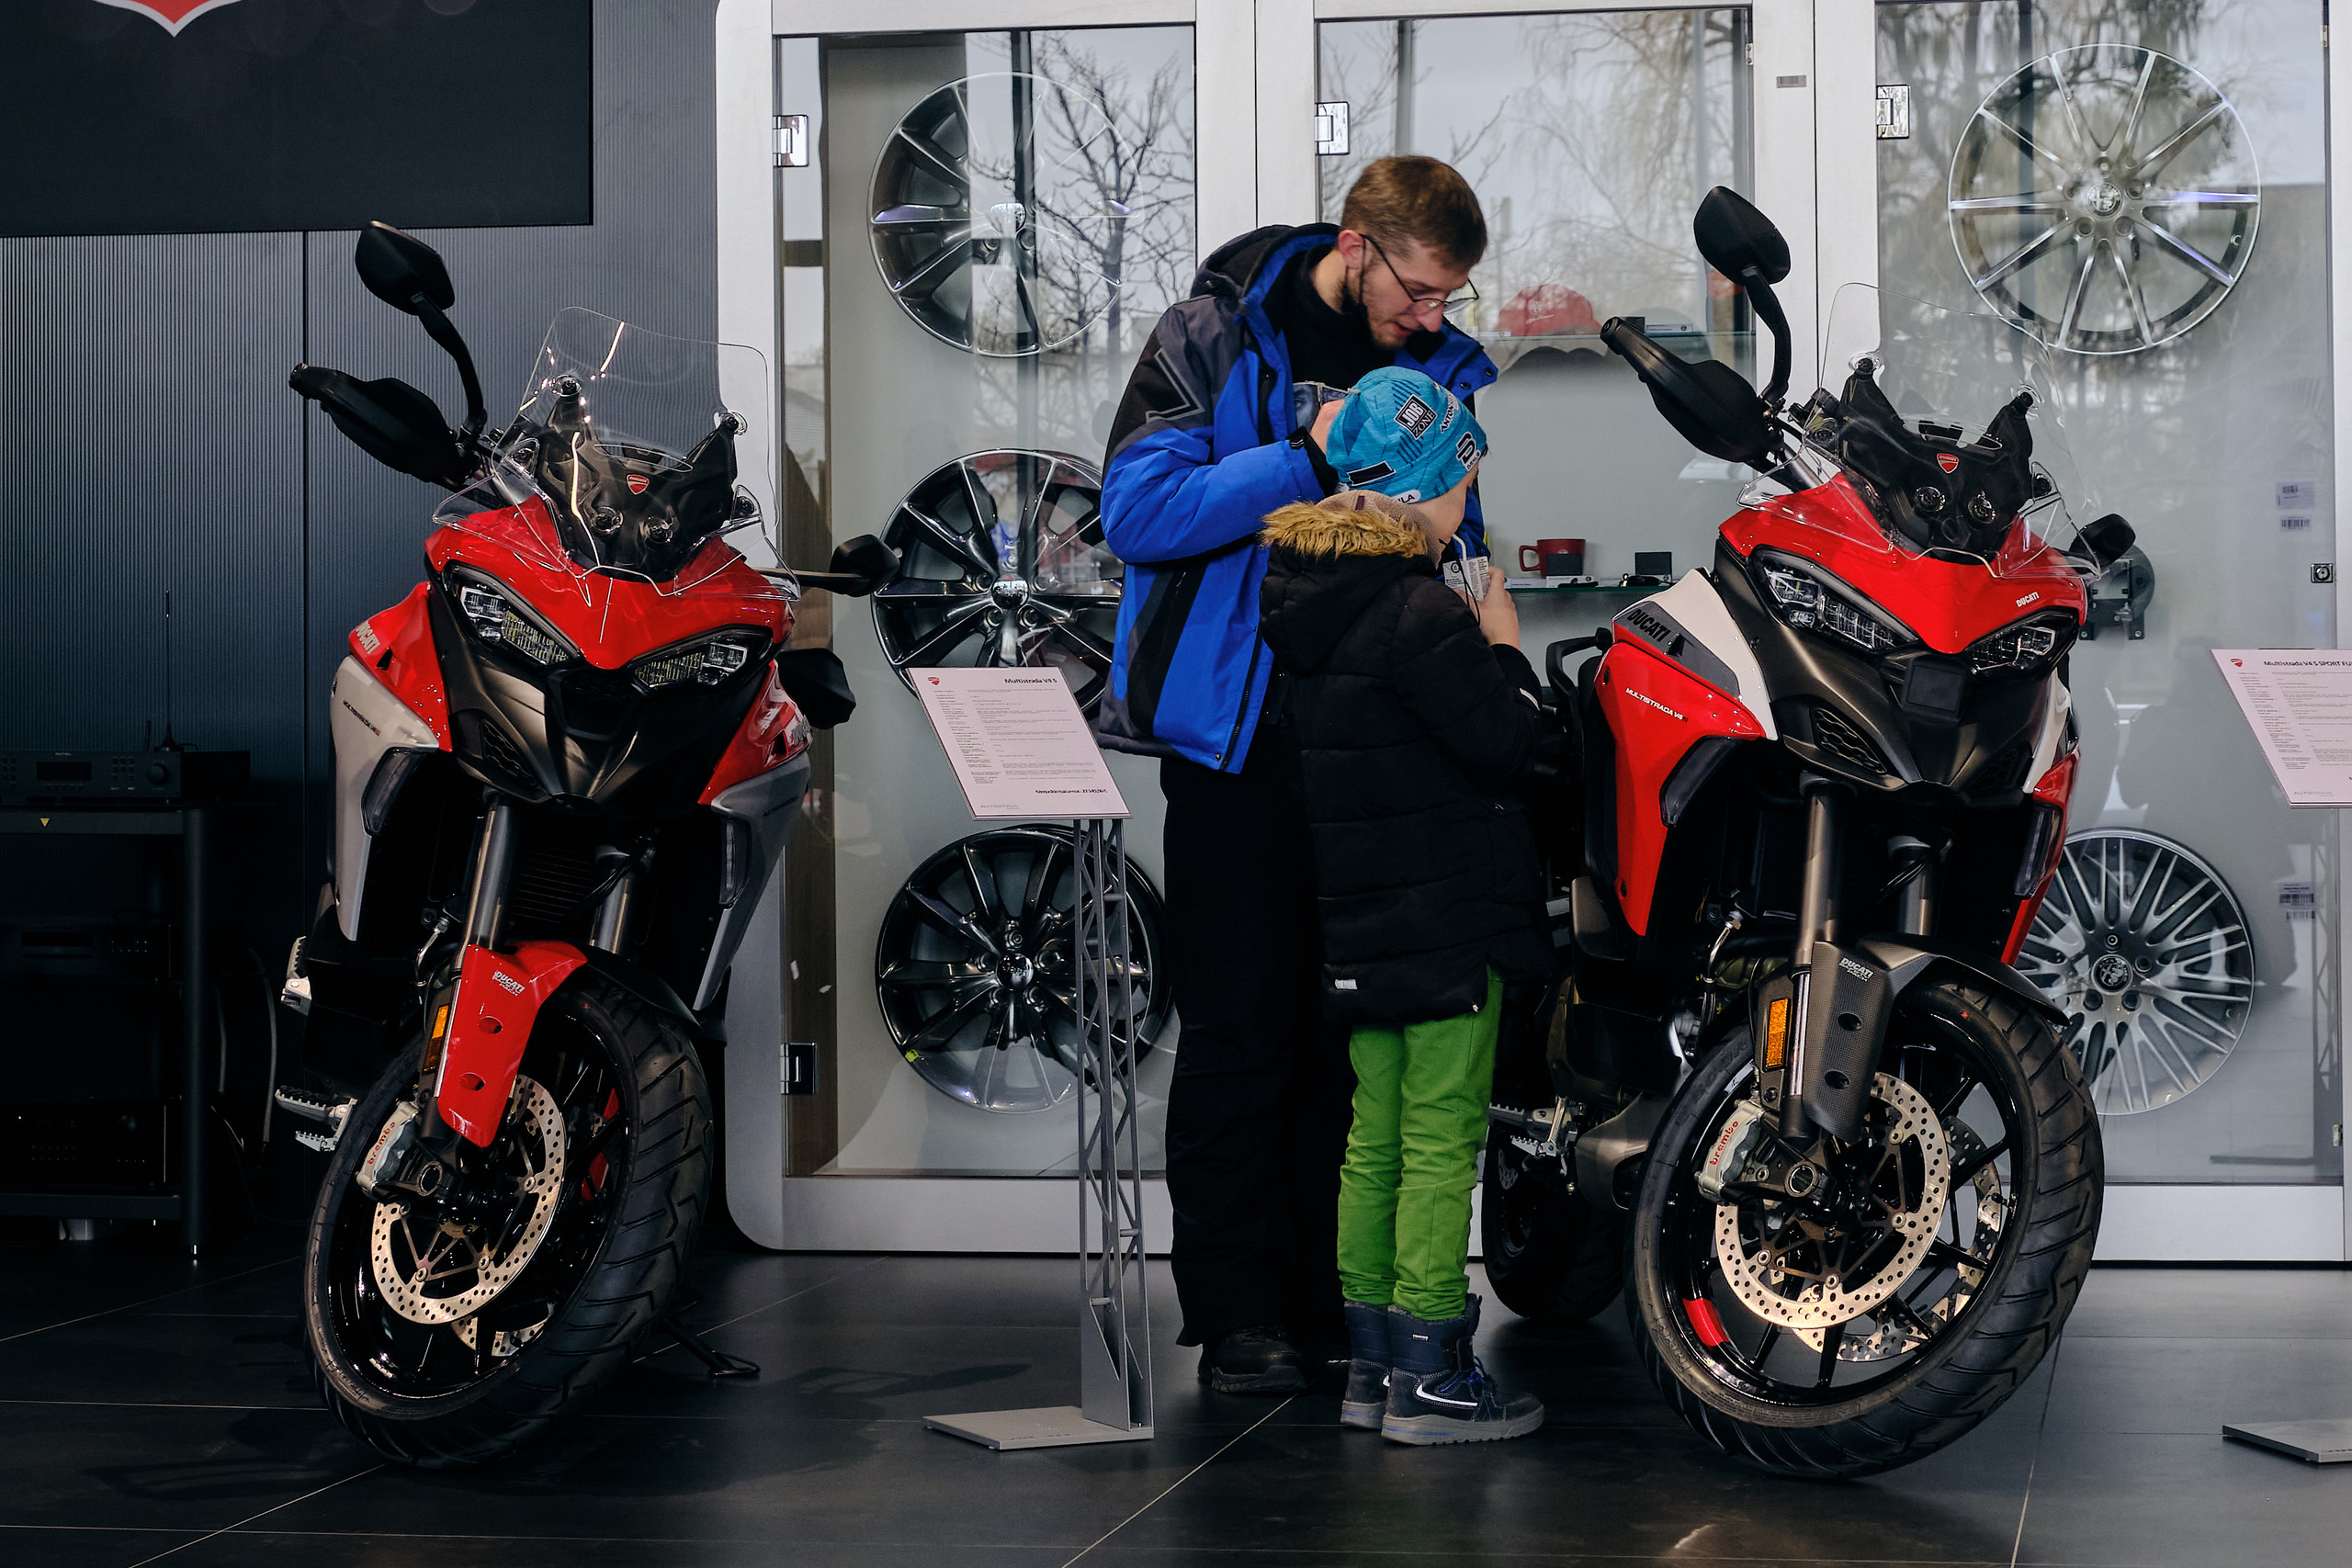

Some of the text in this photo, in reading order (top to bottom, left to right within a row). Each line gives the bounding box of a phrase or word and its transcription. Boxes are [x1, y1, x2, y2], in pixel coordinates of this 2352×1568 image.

[1401, 402, 1424, 427] JOB
[1413, 410, 1435, 436] ZONE
[2016, 592, 2040, 608] DUCATI
[355, 620, 380, 655] DUCATI
[1626, 608, 1671, 642] DUCATI
[1625, 687, 1673, 716] MULTISTRADA
[1840, 957, 1874, 978] DUCATI
[494, 970, 526, 993] DUCATI
[367, 1122, 395, 1165] brembo
[1709, 1121, 1739, 1166] brembo
